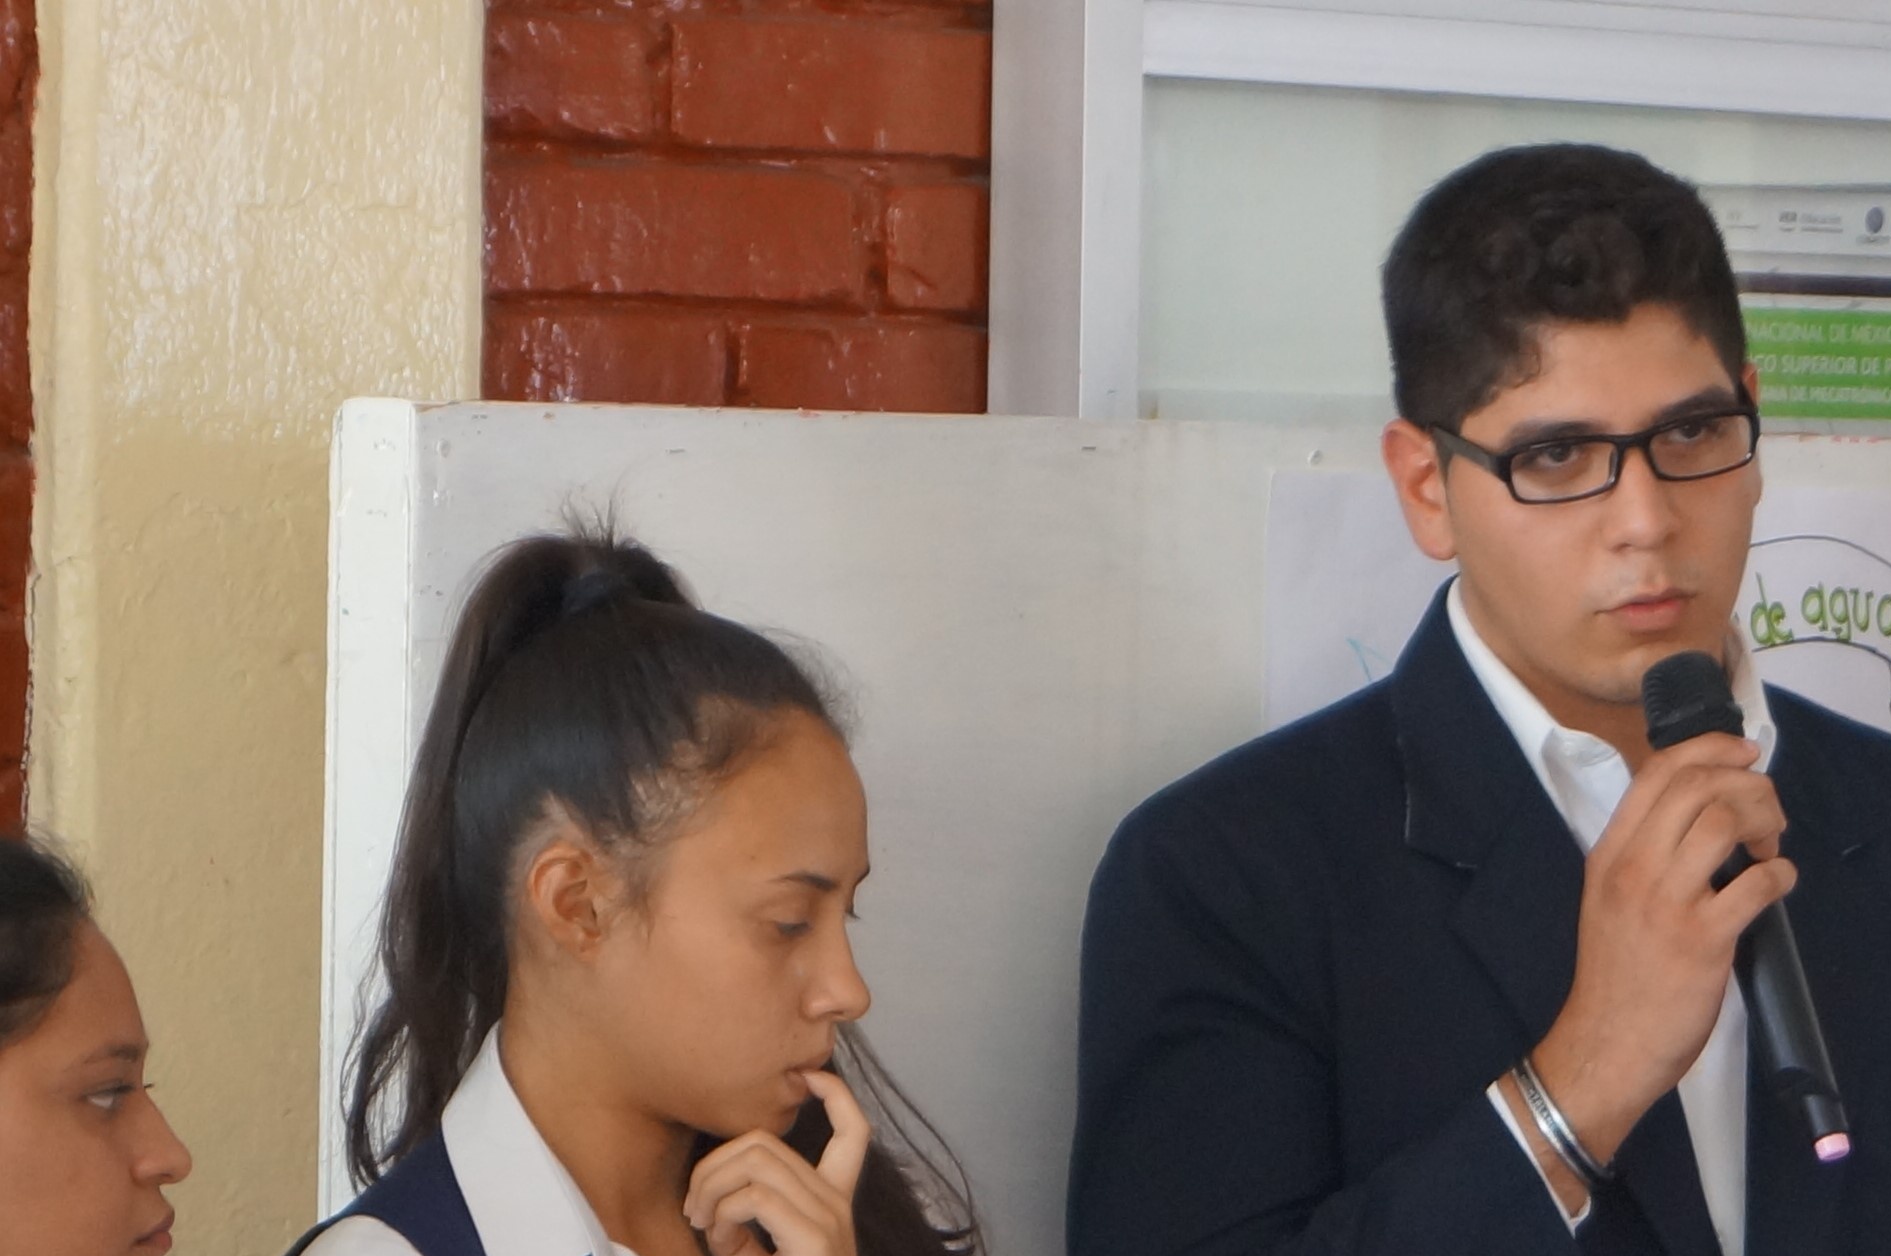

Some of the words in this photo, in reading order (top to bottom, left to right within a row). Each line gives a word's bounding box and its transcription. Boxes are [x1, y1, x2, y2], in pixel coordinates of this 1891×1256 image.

[1749, 353, 1777, 373] CO
[1782, 355, 1858, 374] SUPERIOR
[1861, 356, 1881, 375] DE
[1751, 571, 1794, 646] de
